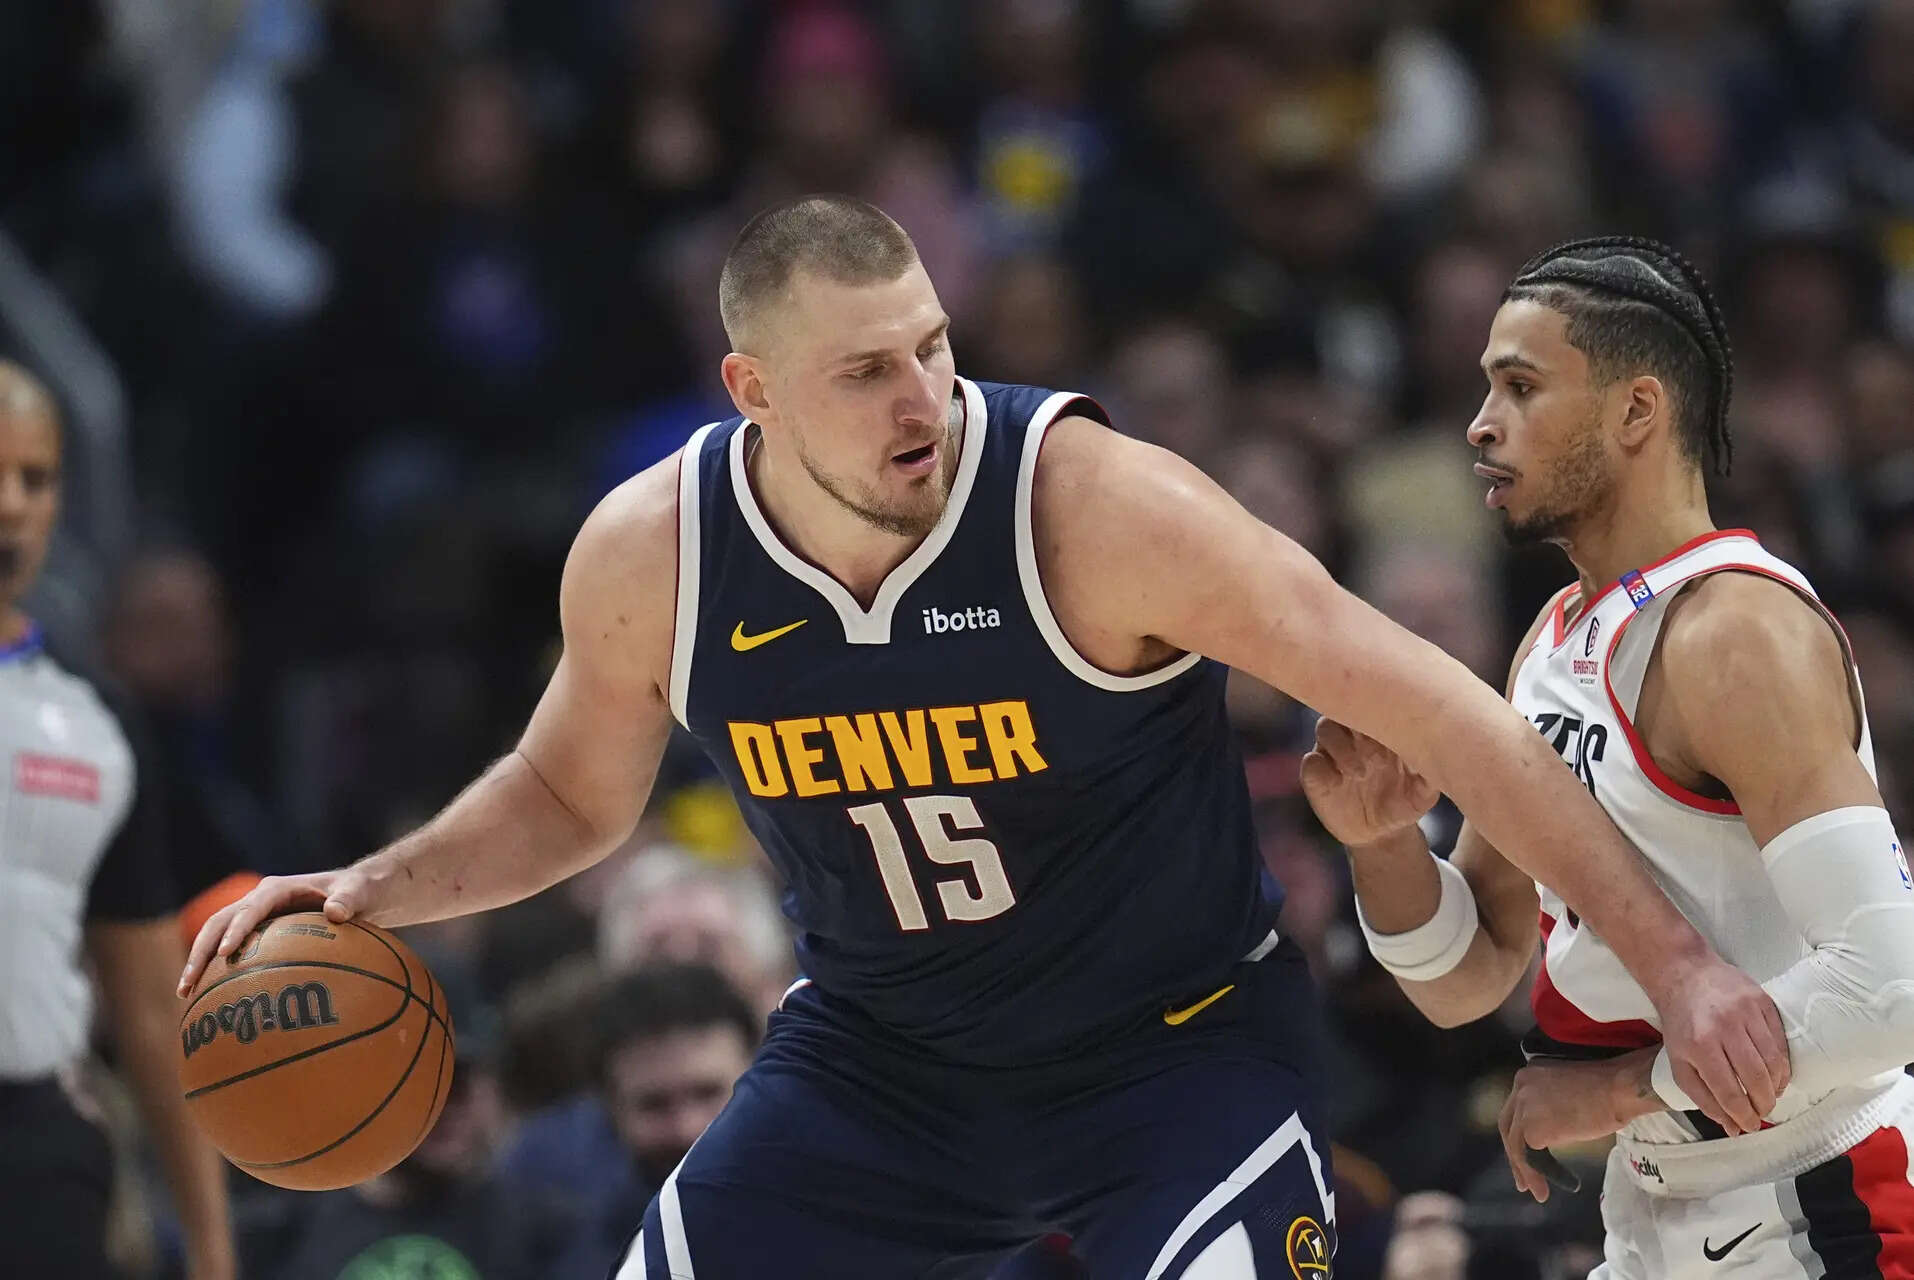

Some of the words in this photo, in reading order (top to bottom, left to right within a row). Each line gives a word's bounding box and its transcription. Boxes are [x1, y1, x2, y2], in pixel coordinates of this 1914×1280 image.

[922, 606, 1001, 634] ibotta
[727, 700, 1049, 798] DENVER
[846, 795, 1017, 931] 15
[182, 981, 340, 1059] Wilson
